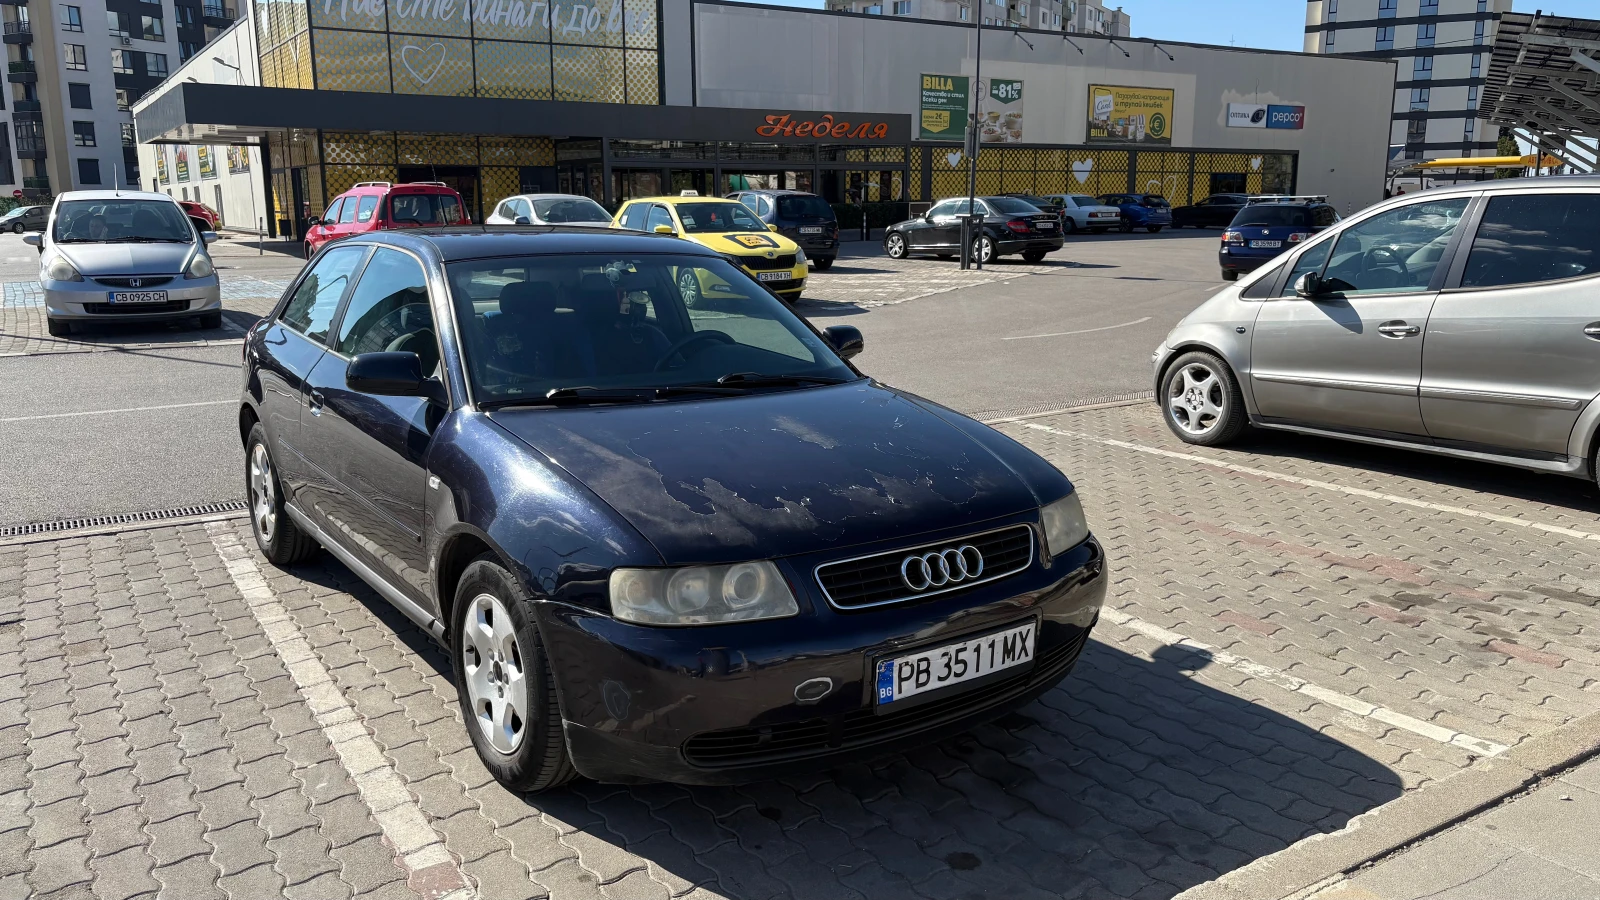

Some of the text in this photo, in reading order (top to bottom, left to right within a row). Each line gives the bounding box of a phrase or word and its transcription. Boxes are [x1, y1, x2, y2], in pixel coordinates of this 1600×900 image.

[562, 4, 601, 37] до
[923, 76, 954, 91] BILLA
[1272, 112, 1300, 123] pepco
[755, 113, 889, 139] Неделя
[1090, 129, 1108, 137] BILLA
[769, 272, 783, 280] 9184
[115, 292, 165, 302] CB 0925 CH
[897, 628, 1031, 695] PB 3511 MX
[879, 686, 892, 699] BG
